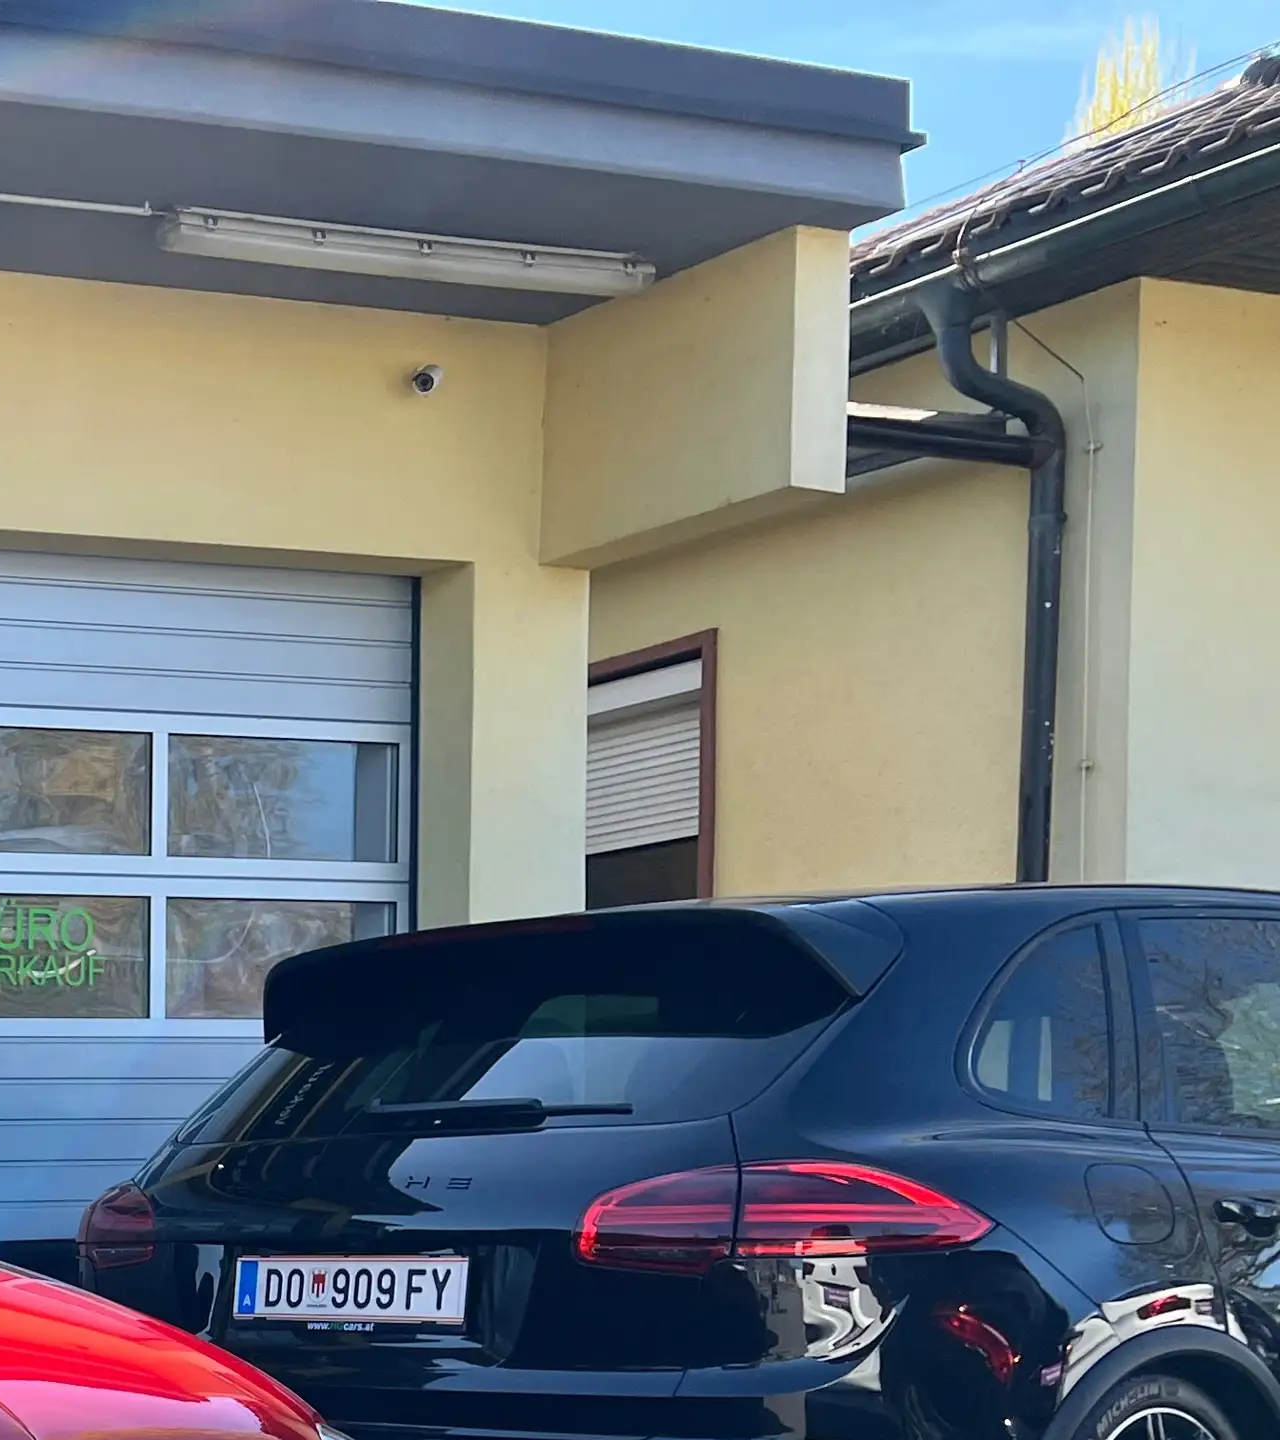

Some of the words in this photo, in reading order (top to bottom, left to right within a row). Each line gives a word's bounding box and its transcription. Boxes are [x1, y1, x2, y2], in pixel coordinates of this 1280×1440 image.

[264, 1268, 304, 1308] DO
[331, 1268, 396, 1309] 909
[405, 1268, 452, 1310] FY
